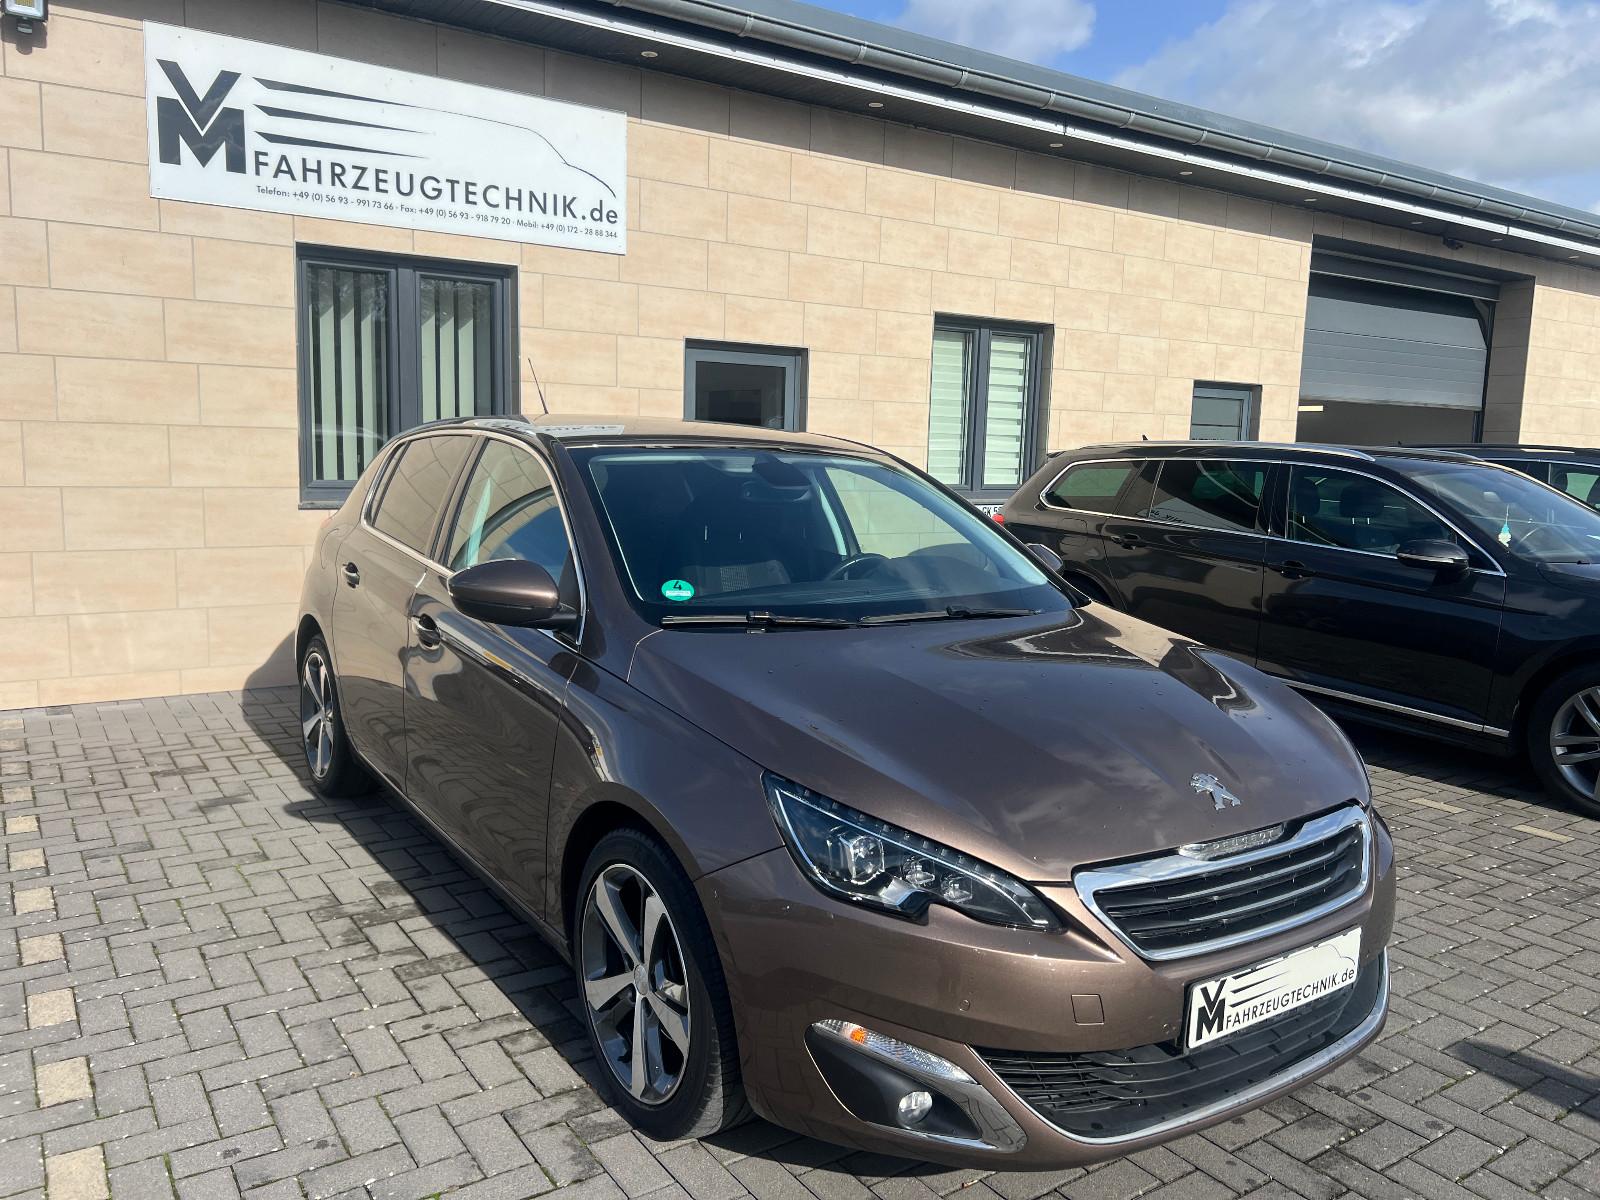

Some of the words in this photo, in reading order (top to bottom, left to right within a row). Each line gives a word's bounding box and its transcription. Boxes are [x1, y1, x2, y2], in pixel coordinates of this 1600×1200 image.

[254, 150, 618, 224] FAHRZEUGTECHNIK.de
[256, 185, 290, 198] Telefon:
[292, 191, 310, 200] +49
[311, 192, 323, 203] (0)
[325, 194, 336, 203] 56
[338, 196, 349, 205] 93
[356, 198, 370, 208] 991
[372, 200, 382, 209] 73
[383, 202, 394, 211] 66
[400, 204, 417, 214] Fax:
[418, 207, 434, 216] +49
[436, 208, 447, 219] (0)
[448, 210, 458, 219] 56
[459, 211, 469, 220] 93
[476, 213, 489, 222] 918
[490, 215, 499, 224] 79
[501, 217, 511, 225] 20
[516, 219, 539, 229] Mobil:
[540, 223, 554, 231] +49
[556, 224, 566, 234] (0)
[567, 225, 578, 234] 172
[672, 580, 682, 591] 4
[1226, 968, 1355, 1030] FAHRZEUGTECHNIK.de
